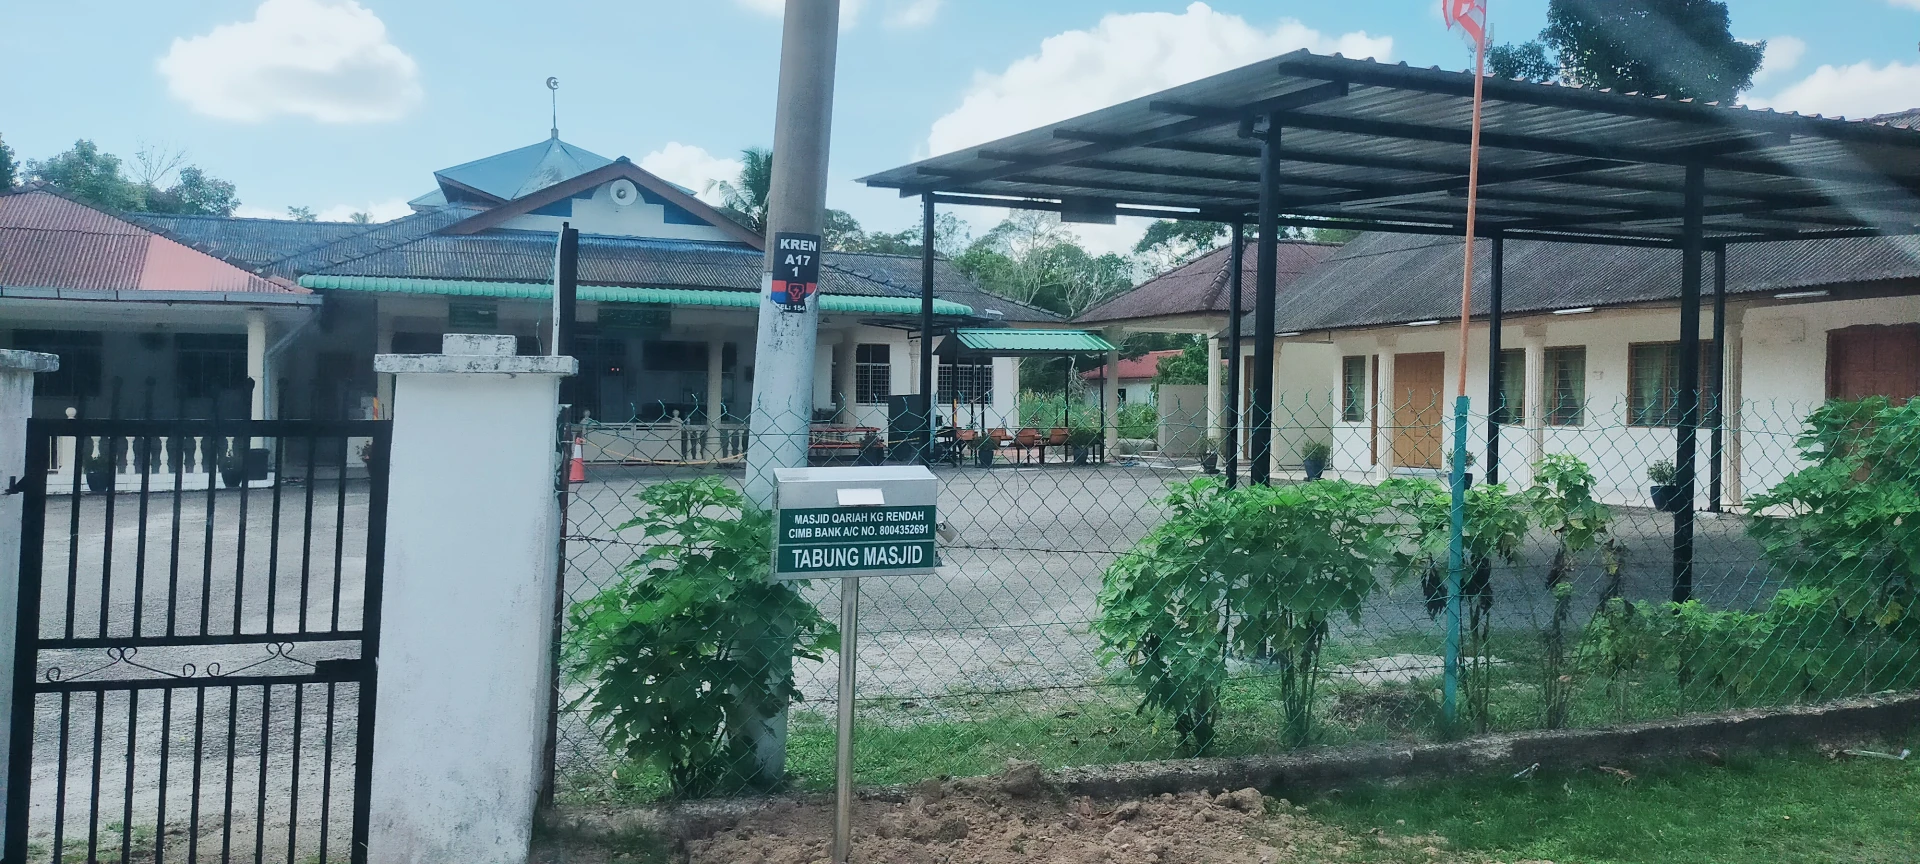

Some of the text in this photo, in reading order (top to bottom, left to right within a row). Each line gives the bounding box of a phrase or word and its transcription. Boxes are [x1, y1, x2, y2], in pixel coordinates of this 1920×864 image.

[780, 238, 817, 252] KREN
[784, 253, 811, 266] A17
[792, 266, 799, 277] 1
[794, 510, 925, 525] MASJID QARIAH KG RENDAH
[788, 523, 929, 539] CIMB BANK A/C NO. 8004352691
[792, 545, 923, 569] TABUNG MASJID
